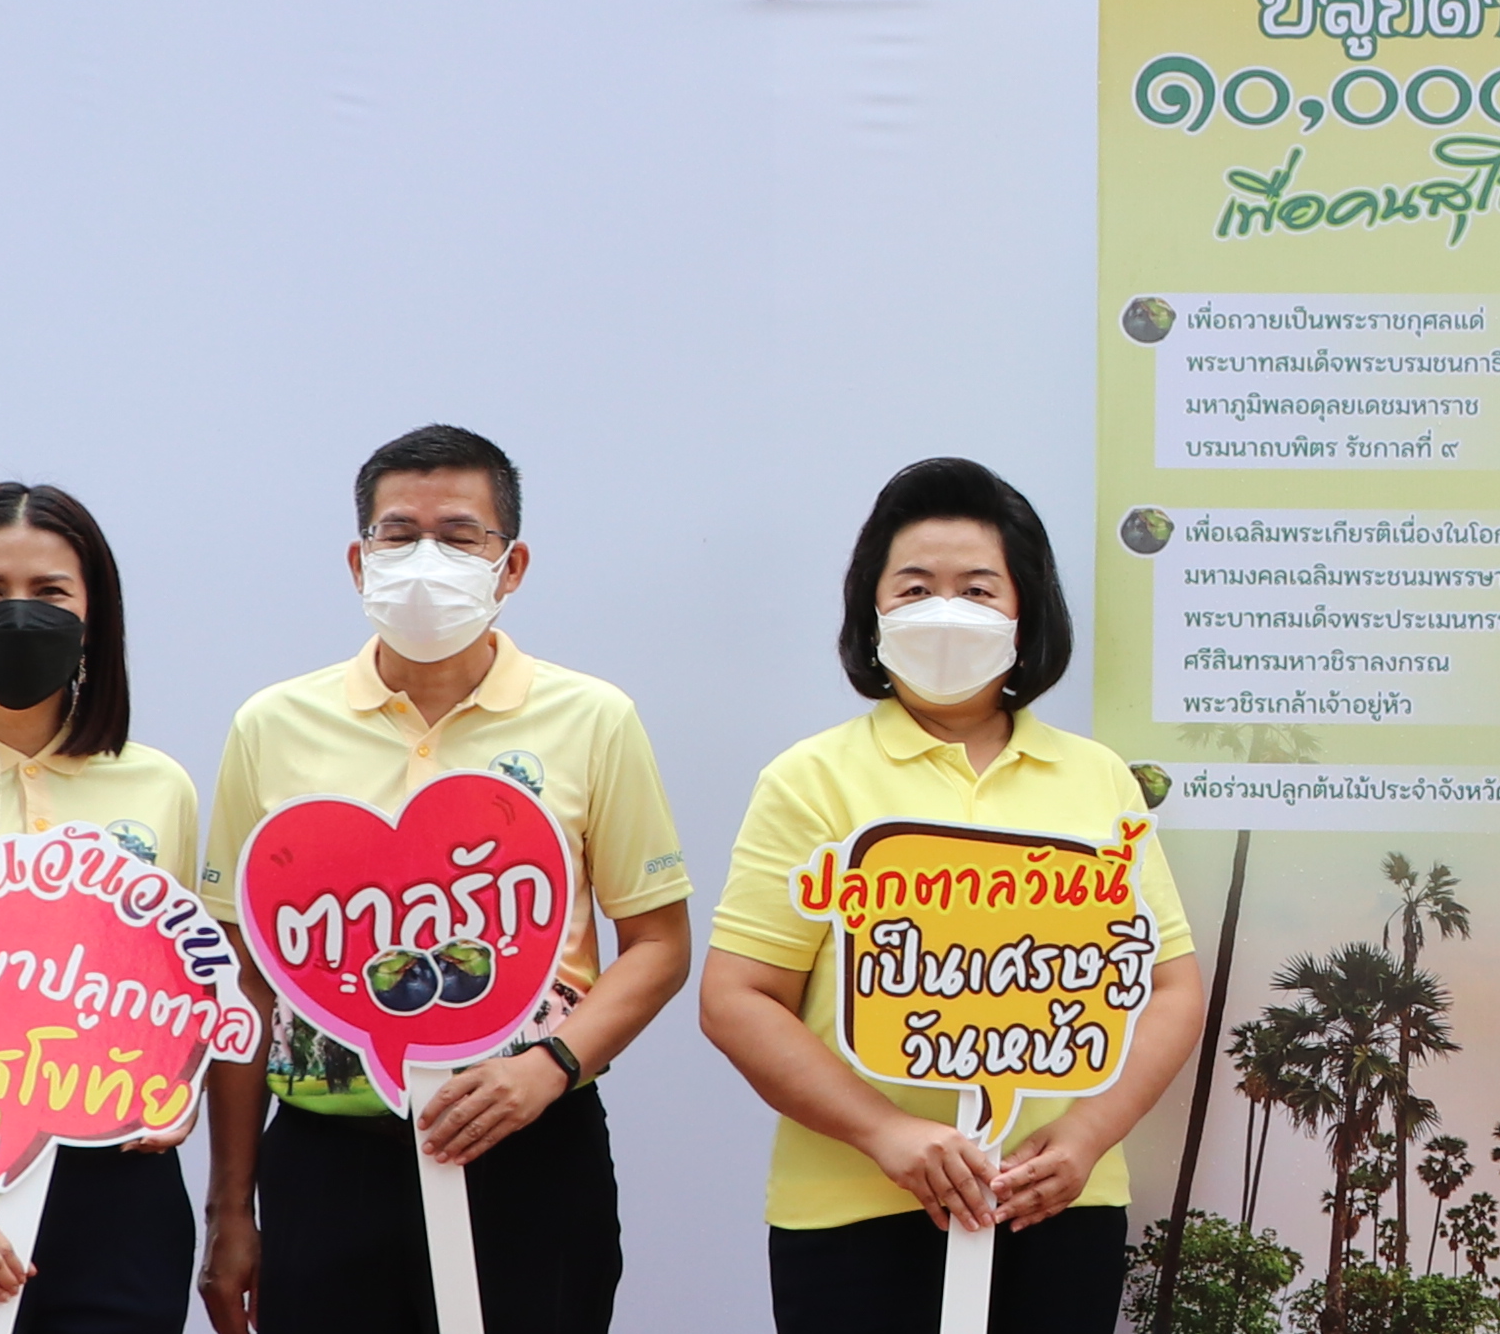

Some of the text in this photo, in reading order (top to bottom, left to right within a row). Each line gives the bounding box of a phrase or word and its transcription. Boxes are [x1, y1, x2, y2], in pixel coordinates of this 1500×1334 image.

[1186, 301, 1485, 337] เพื่อถวายเป็นพระราชกุศลแด่
[1186, 392, 1479, 422] มหาภูมิพลอดุลยเดชมหาราช
[1186, 430, 1459, 459] บรมนาถบพิตร รัชกาลที่ ๙
[1184, 648, 1450, 672] ศรีสินทรมหาวชิราลงกรณ
[1184, 691, 1412, 721] พระวชิรเกล้าเจ้าอยู่หัว
[800, 820, 1147, 928] ปลูกตาลวันนี้
[276, 840, 552, 969] ตาลรัก
[858, 915, 1155, 1008] เป็นเศรษฐี
[903, 1000, 1108, 1078] วันหน้า
